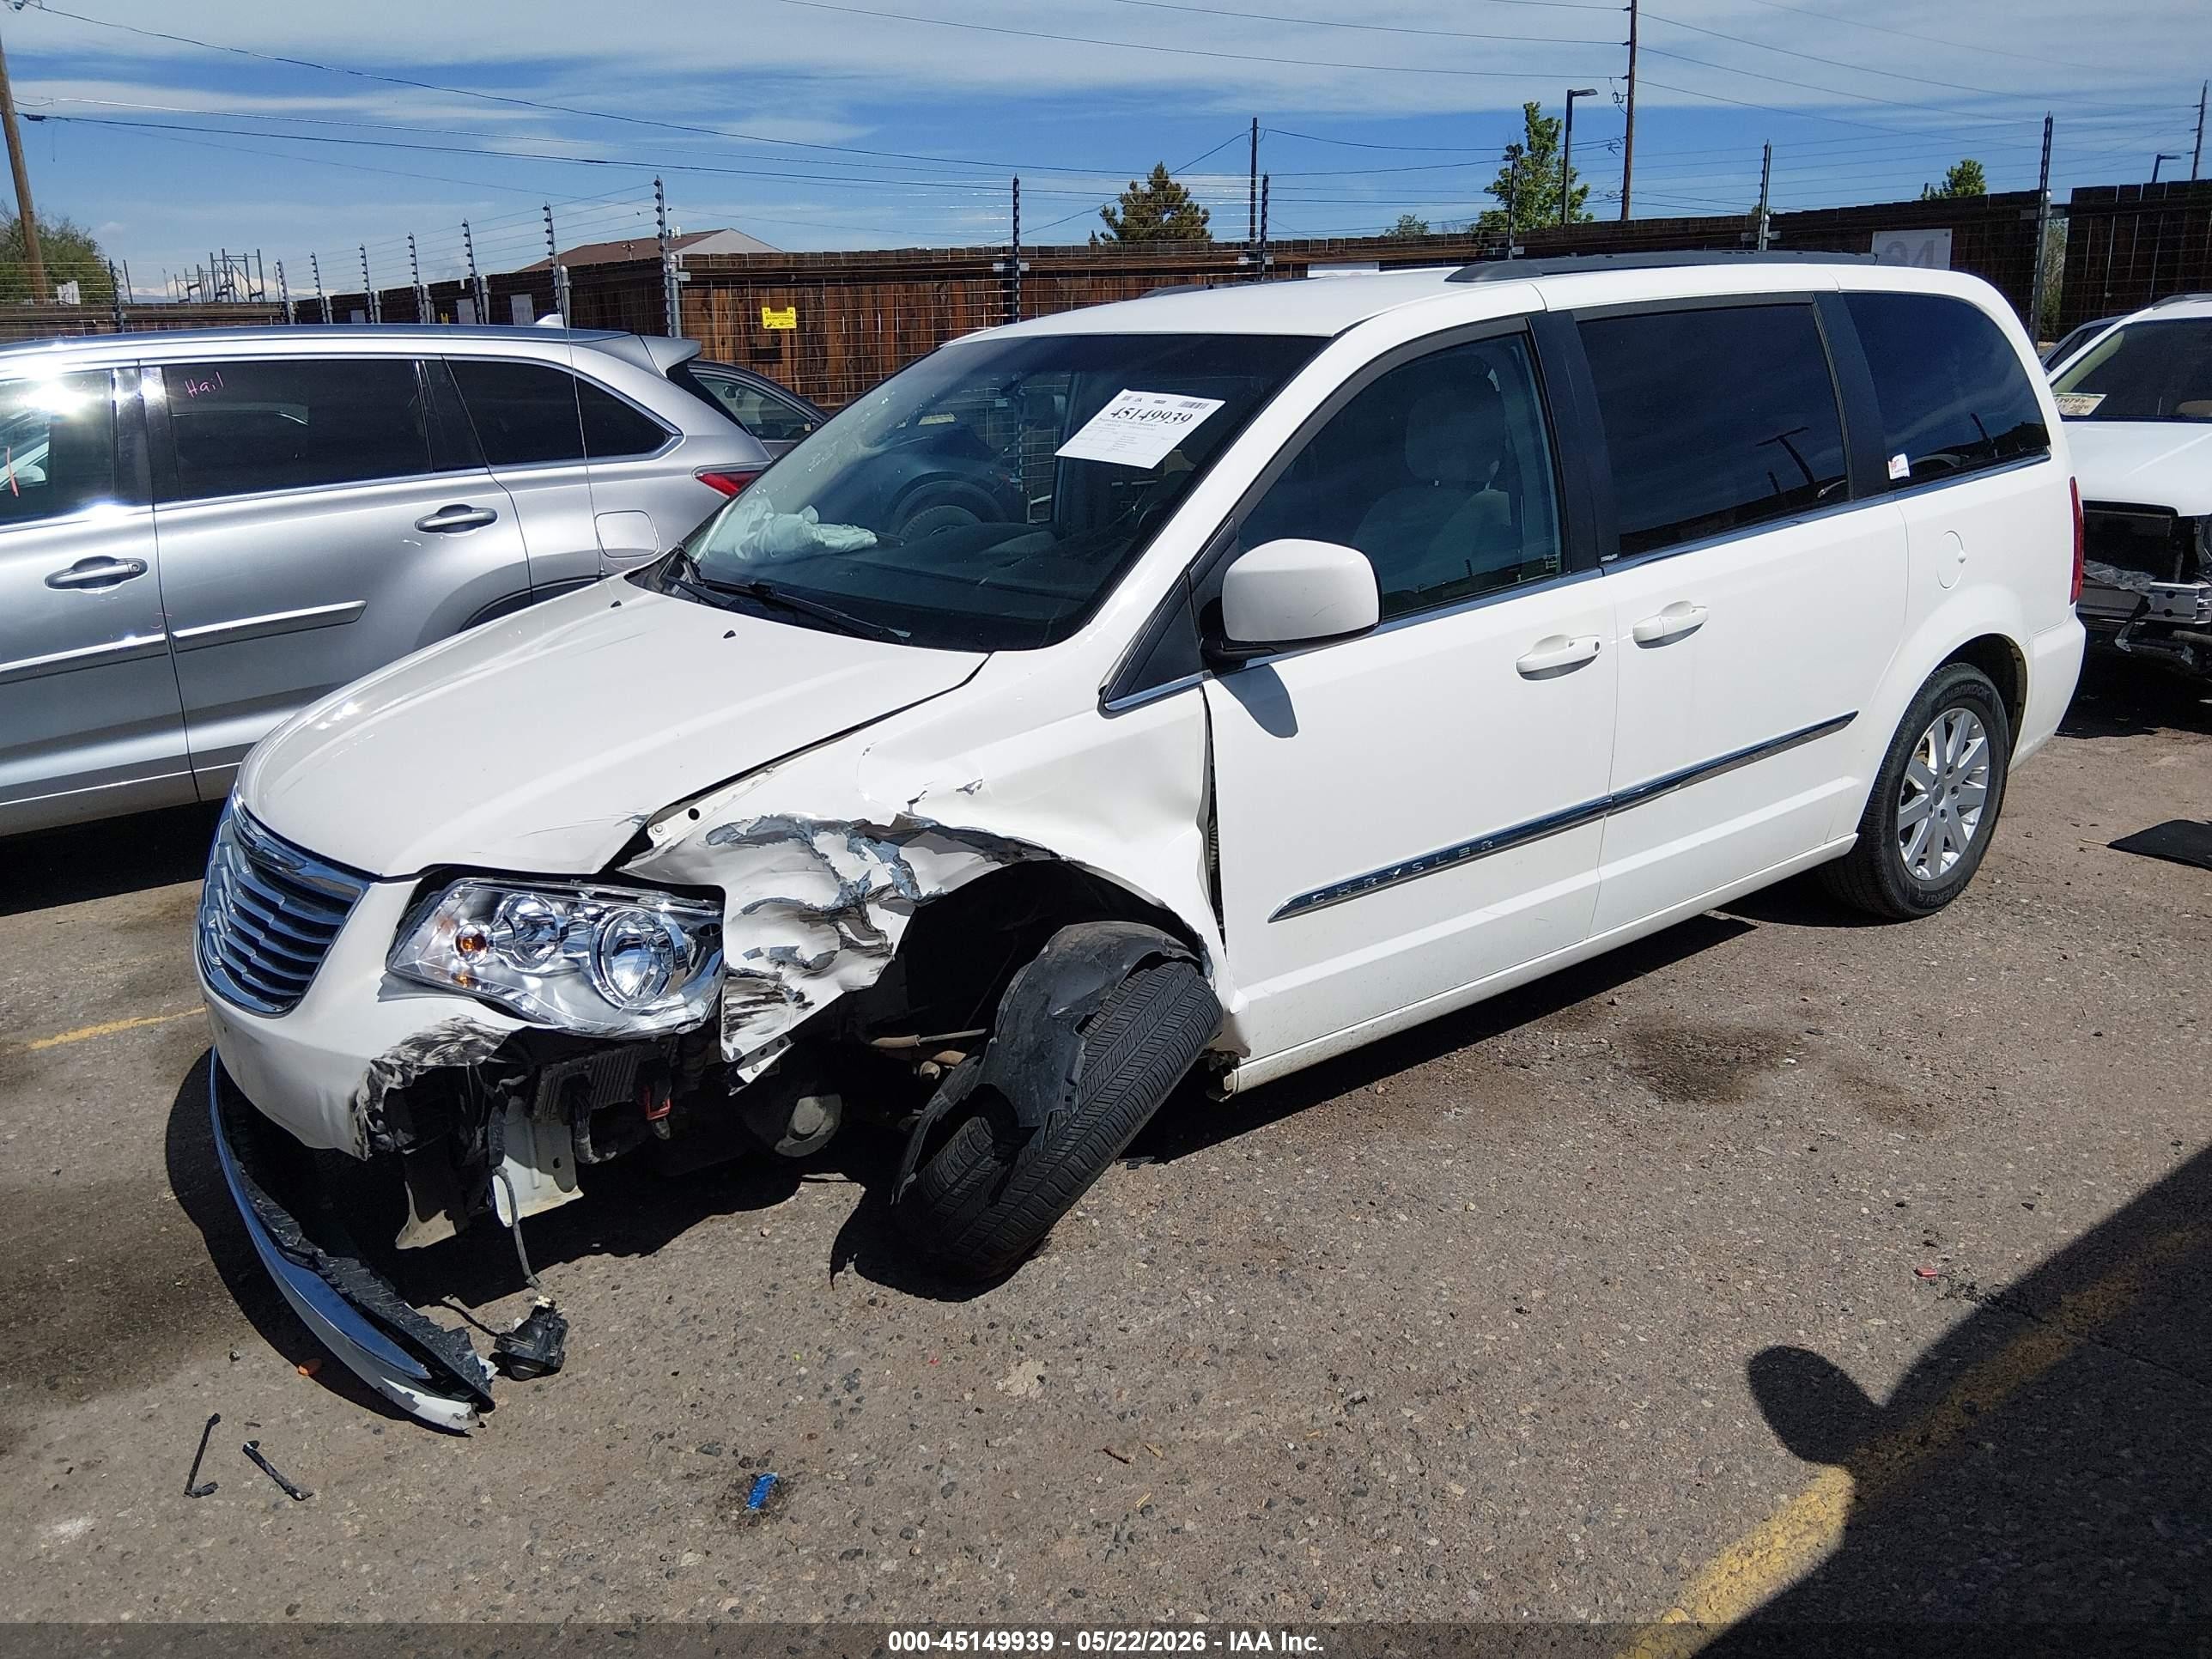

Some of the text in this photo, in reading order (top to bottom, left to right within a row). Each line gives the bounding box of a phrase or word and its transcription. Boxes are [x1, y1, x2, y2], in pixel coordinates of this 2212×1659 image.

[185, 371, 223, 398] Hail
[1110, 406, 1194, 426] 45149939
[1311, 839, 1494, 904] CHRYSLER
